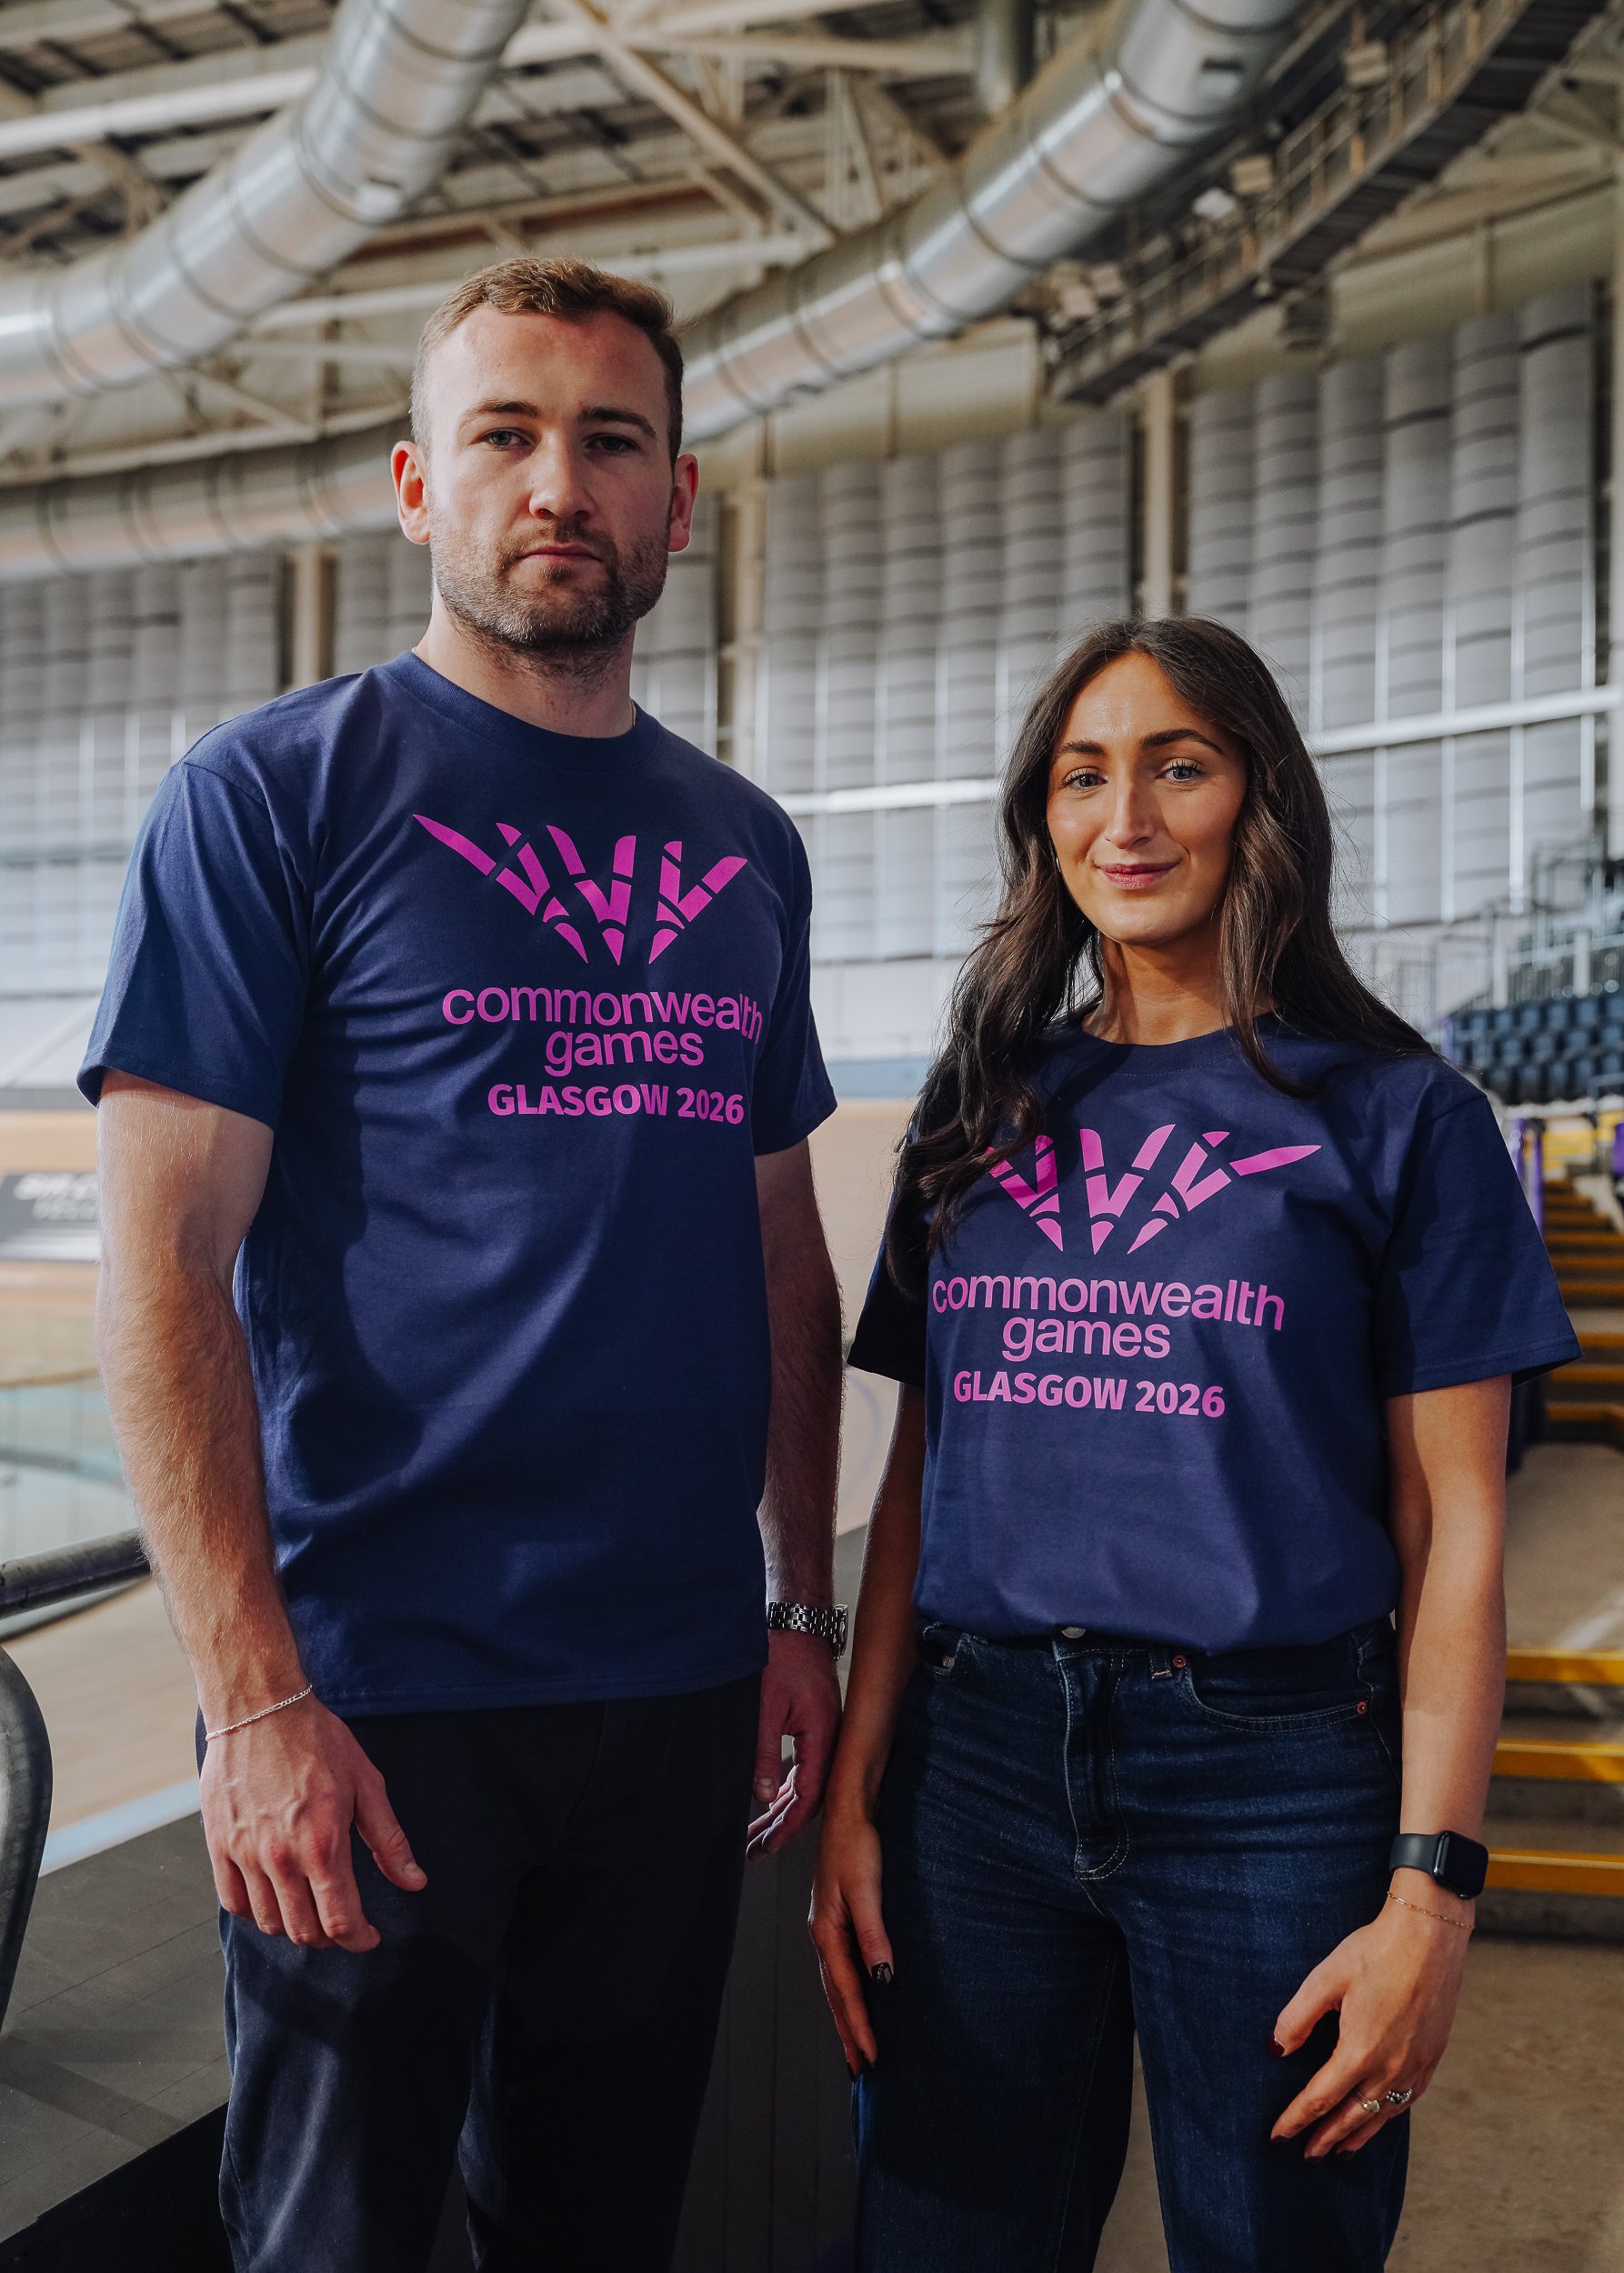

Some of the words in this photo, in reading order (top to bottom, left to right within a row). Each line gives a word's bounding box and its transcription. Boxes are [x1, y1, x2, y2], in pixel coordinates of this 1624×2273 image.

[441, 986, 764, 1045] commonwealth
[544, 1030, 705, 1077] games
[486, 1083, 669, 1118] GLASGOW
[676, 1086, 745, 1125] 2026
[932, 1275, 1285, 1331] commonwealth
[1002, 1317, 1171, 1363] games
[953, 1370, 1128, 1410] GLASGOW
[1135, 1380, 1227, 1418] 2026
